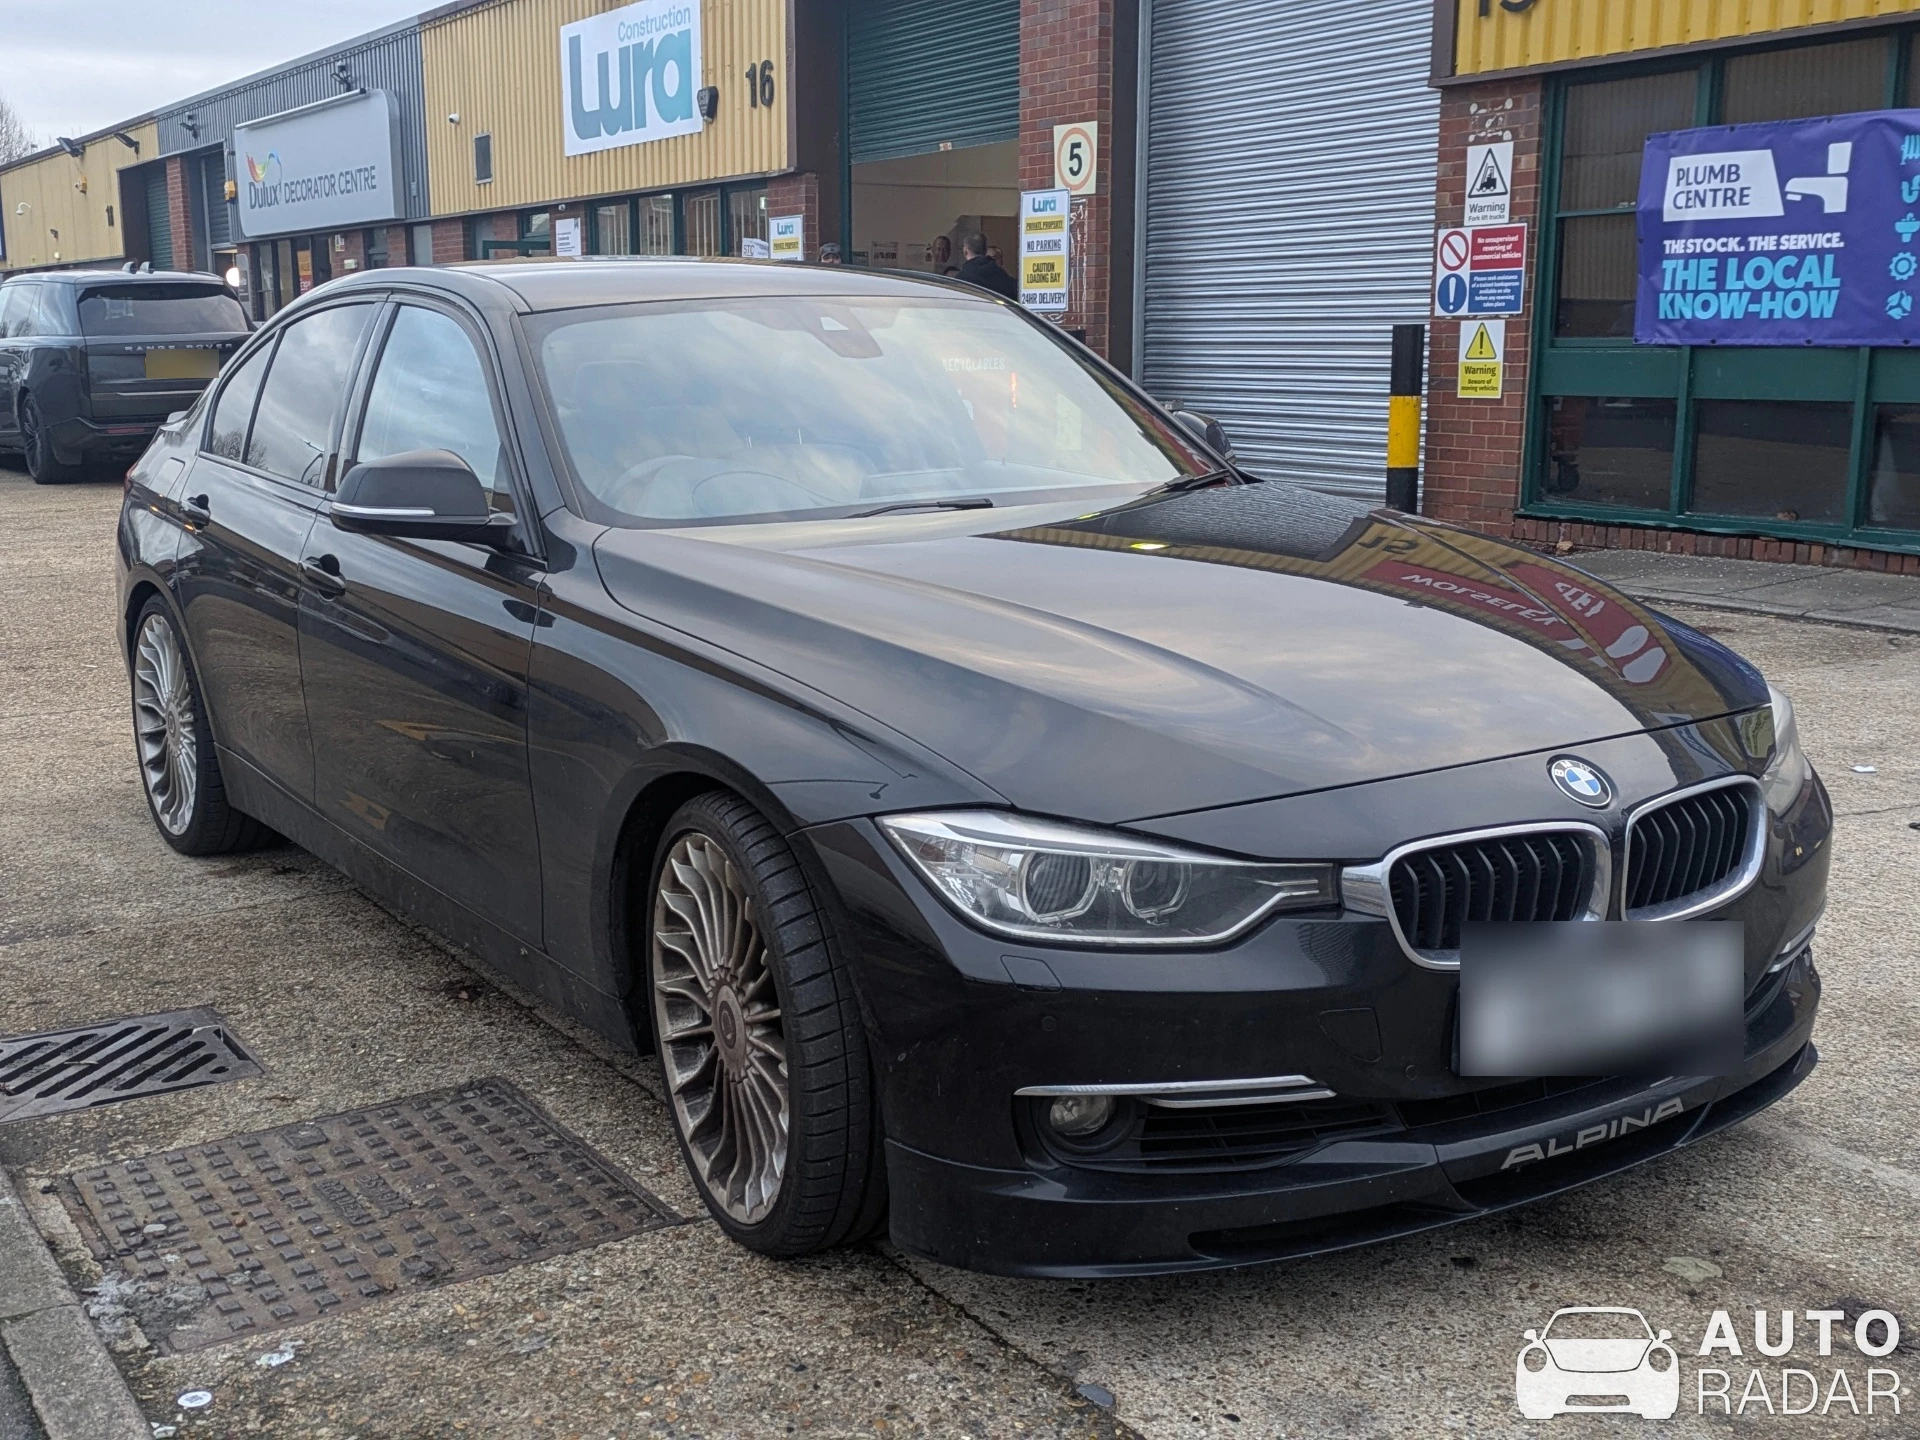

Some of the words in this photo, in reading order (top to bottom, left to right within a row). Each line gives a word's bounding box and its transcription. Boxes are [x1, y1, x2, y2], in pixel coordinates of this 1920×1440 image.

[618, 5, 691, 42] Construction
[568, 28, 693, 140] Lura
[745, 59, 775, 109] 16
[1068, 141, 1083, 177] 5
[1675, 163, 1741, 187] PLUMB
[248, 181, 279, 209] Dulux
[284, 173, 338, 204] DECORATOR
[338, 165, 377, 196] CENTRE
[1032, 197, 1057, 213] Lura
[1469, 202, 1506, 213] Warning
[1672, 186, 1752, 210] CENTRE
[777, 222, 794, 235] Lura
[1027, 240, 1035, 251] NO
[1036, 239, 1062, 251] PARKING
[1482, 244, 1506, 252] reversing
[1485, 235, 1519, 243] unsupervised
[1663, 239, 1685, 254] THE
[1685, 237, 1745, 253] STOCK.
[1748, 235, 1777, 251] THE
[1779, 232, 1845, 250] SERVICE.
[1472, 252, 1501, 260] commercial
[1032, 262, 1055, 273] CAUTION
[1662, 258, 1718, 290] THE
[1725, 254, 1841, 290] LOCAL
[1026, 273, 1050, 283] LOADING
[1050, 272, 1061, 282] BAY
[1022, 292, 1038, 304] 24HR
[1038, 292, 1066, 304] DELIVERY
[1659, 289, 1840, 320] KNOW-HOW
[1464, 364, 1497, 377] Warning
[1500, 1097, 1685, 1170] ALPINA
